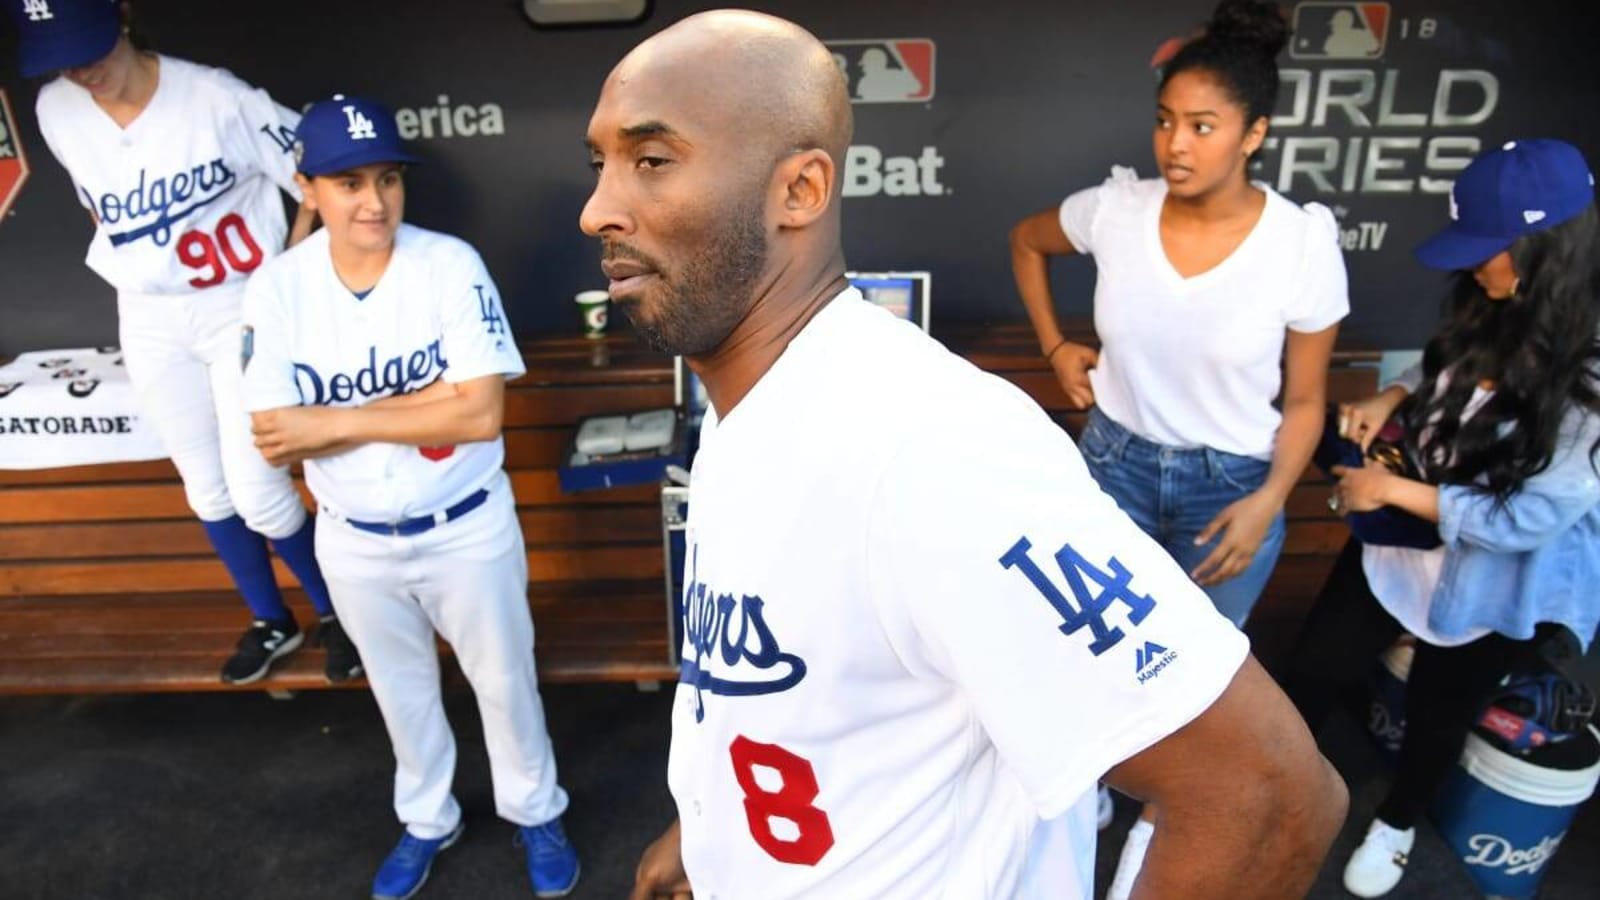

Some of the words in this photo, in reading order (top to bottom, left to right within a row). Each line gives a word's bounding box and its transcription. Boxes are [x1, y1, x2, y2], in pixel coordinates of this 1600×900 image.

[342, 105, 377, 140] LA
[395, 95, 505, 140] erica
[1269, 69, 1500, 127] ORLD
[1253, 136, 1482, 193] RIES
[175, 212, 264, 289] 90
[292, 340, 449, 407] Dodger
[0, 416, 132, 434] ATORADE
[998, 535, 1157, 657] LA
[1137, 650, 1179, 685] Majestic
[729, 734, 835, 867] 8
